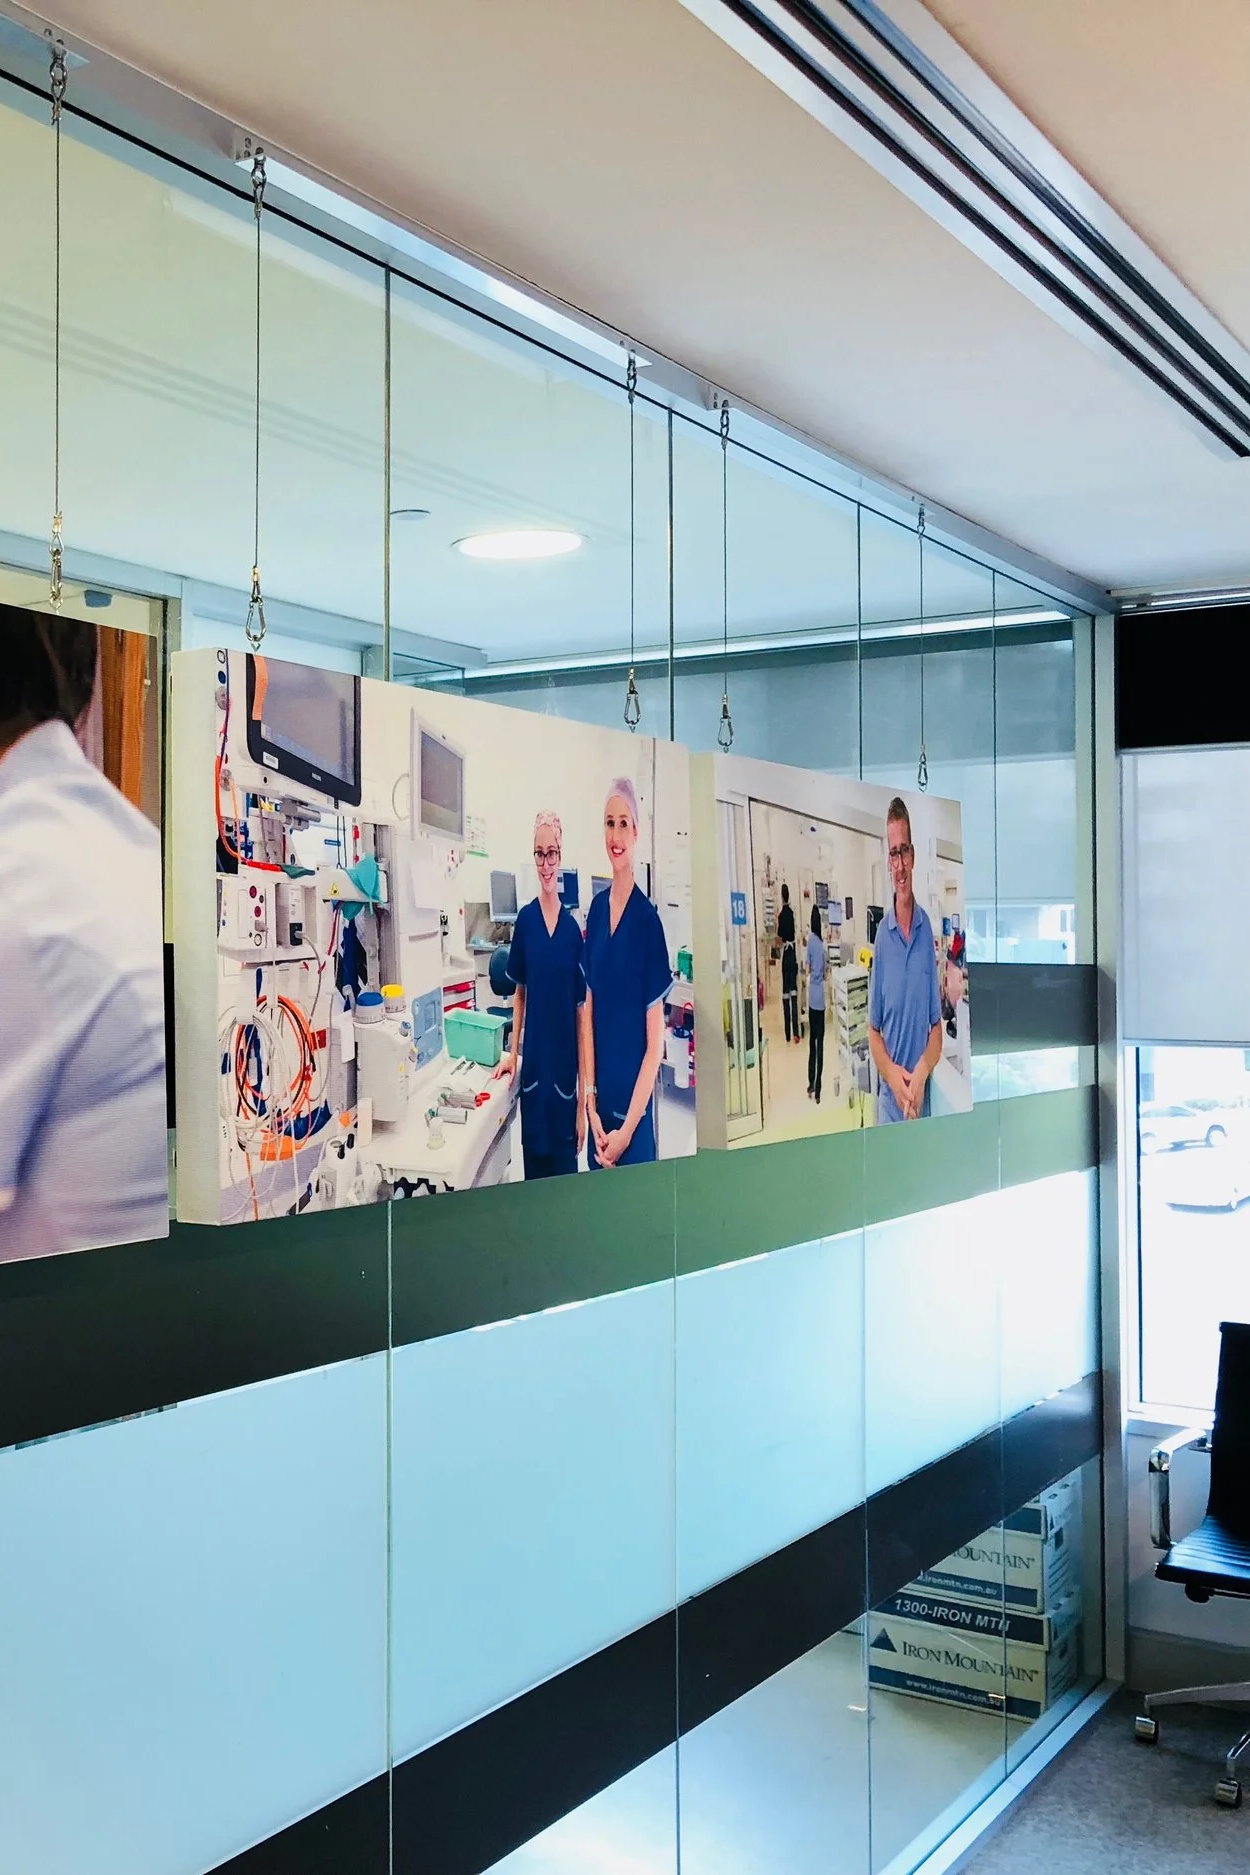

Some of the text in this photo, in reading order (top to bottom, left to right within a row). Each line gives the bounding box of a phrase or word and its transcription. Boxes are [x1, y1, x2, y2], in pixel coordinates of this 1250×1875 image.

[732, 899, 745, 919] 18
[895, 1599, 972, 1626] 1300-IRON
[902, 1641, 1034, 1683] IRON MOUNTAIN
